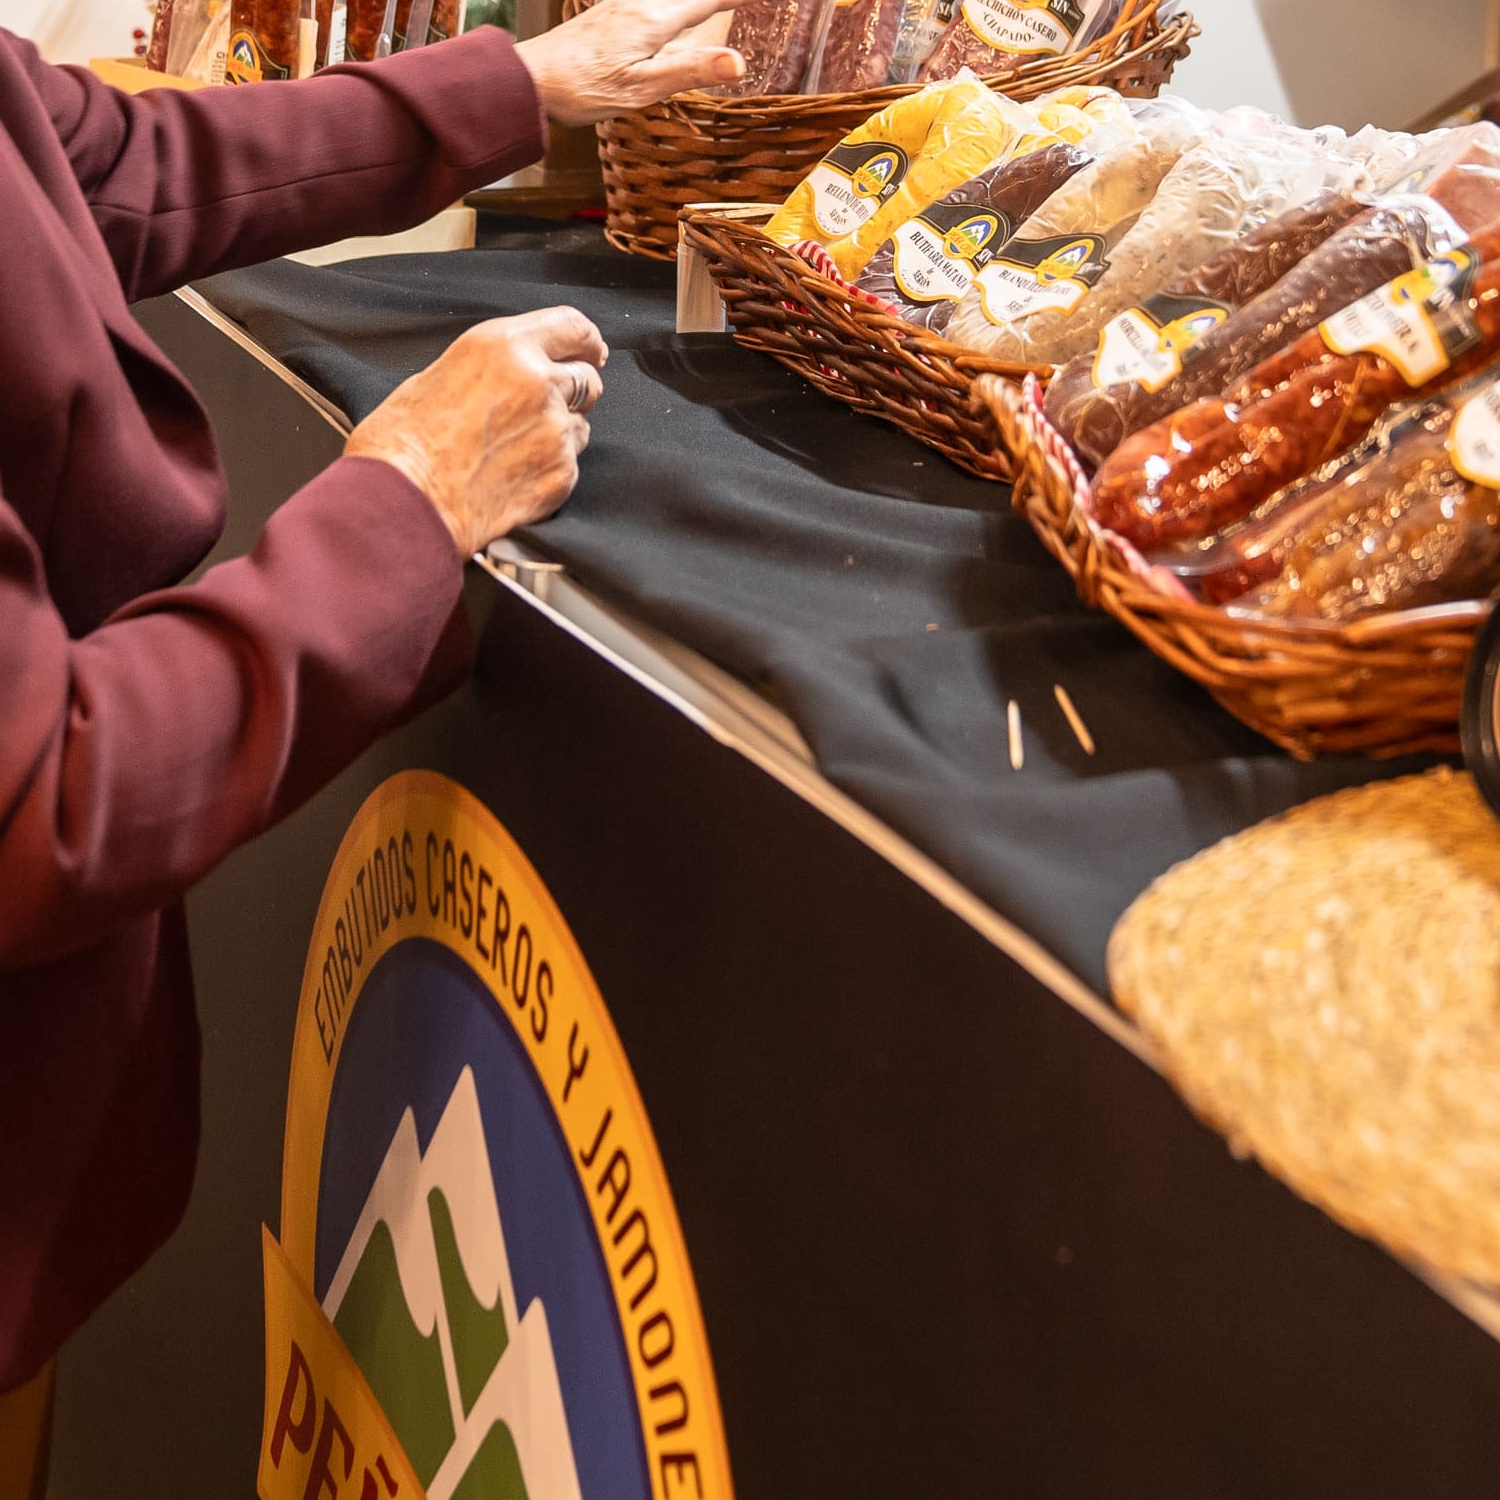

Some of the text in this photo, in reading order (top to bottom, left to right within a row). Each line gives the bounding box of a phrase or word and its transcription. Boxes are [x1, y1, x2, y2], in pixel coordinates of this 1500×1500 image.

[1025, 14, 1058, 42] CASERO
[909, 231, 945, 267] BUTIFARRA
[942, 261, 969, 289] MATANZA
[314, 829, 417, 1067] EMBUTIDOS
[426, 831, 554, 1043] CASEROS
[563, 1019, 589, 1103] Y
